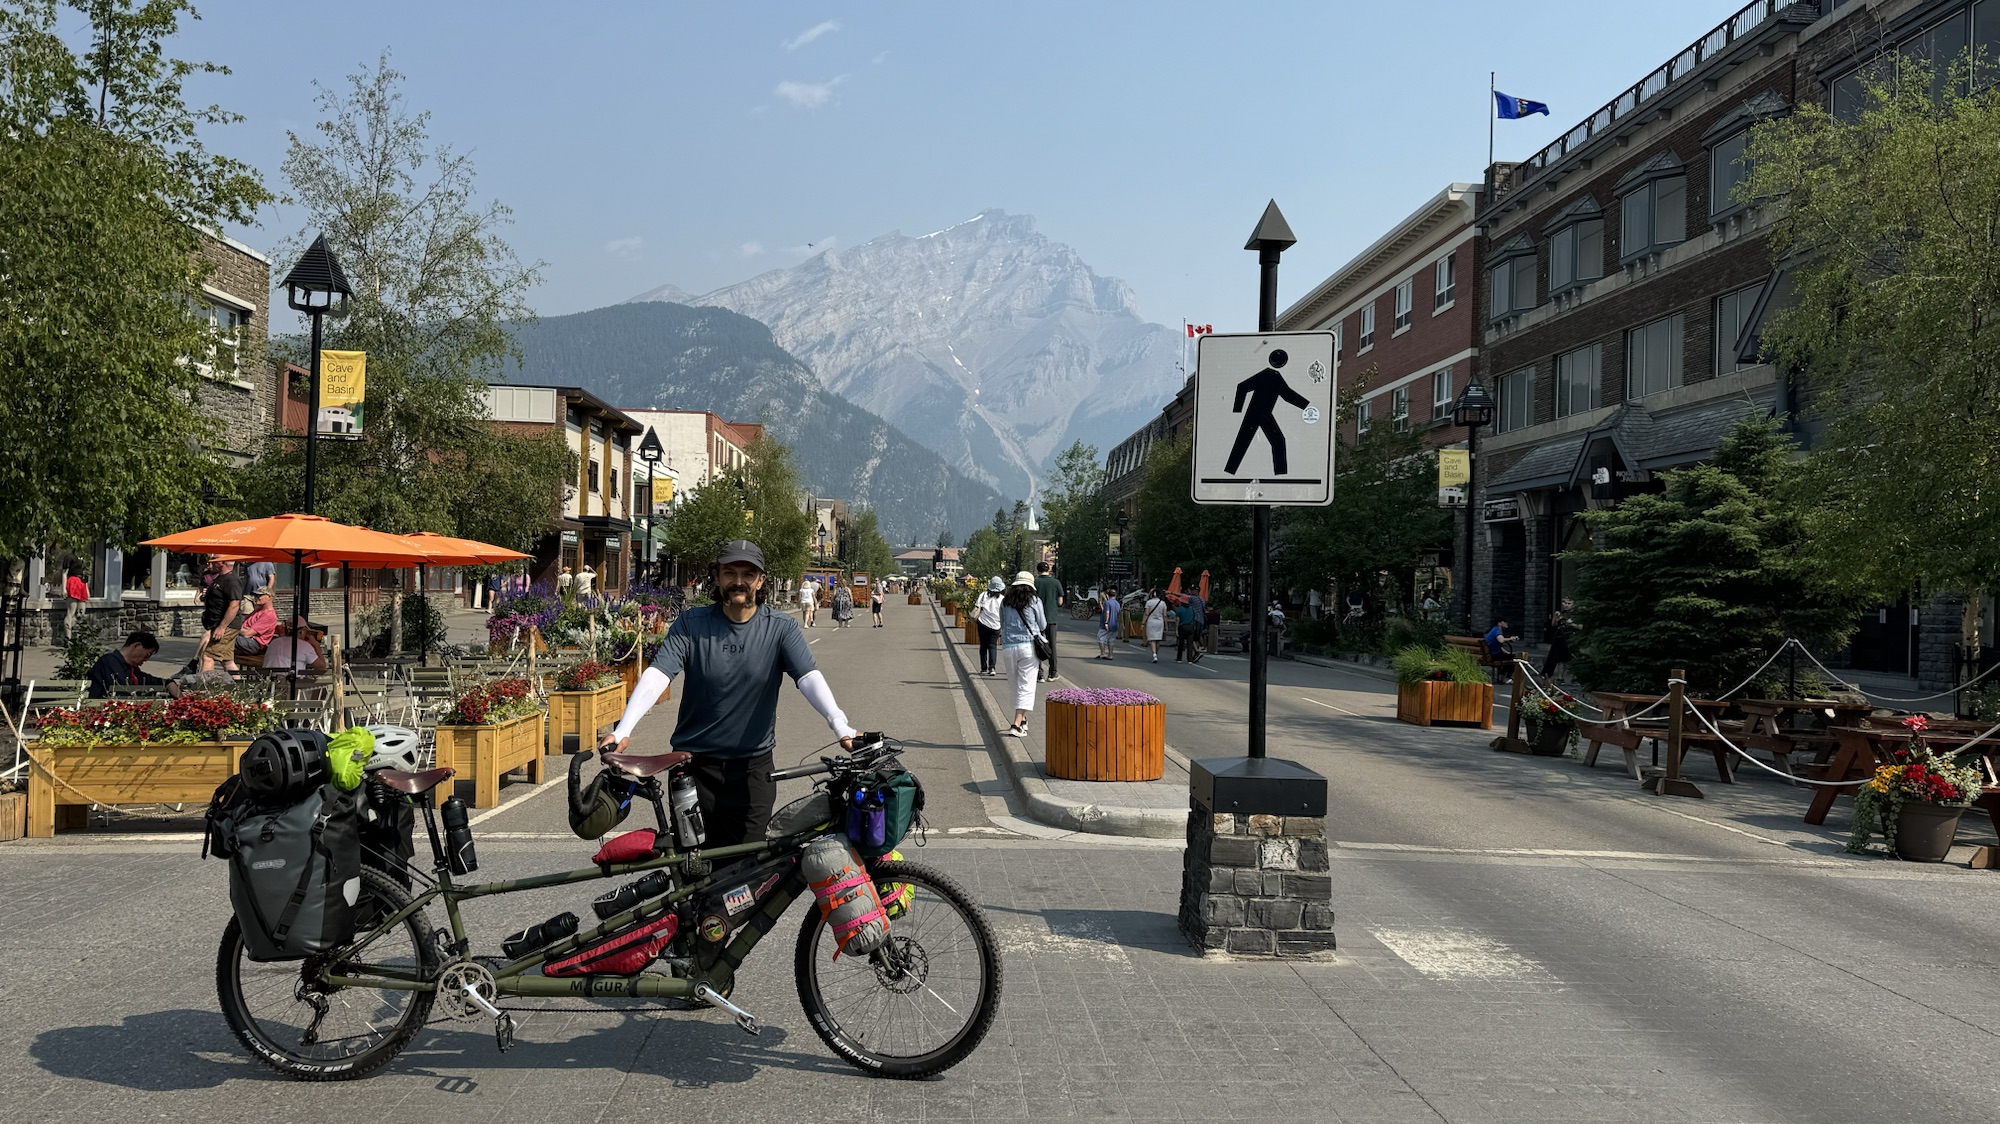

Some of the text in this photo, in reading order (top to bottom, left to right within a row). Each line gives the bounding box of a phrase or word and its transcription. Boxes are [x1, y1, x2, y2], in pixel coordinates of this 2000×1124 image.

[327, 362, 354, 373] Cave
[327, 374, 347, 383] and
[327, 384, 355, 394] Basin
[722, 644, 745, 653] FOX
[570, 980, 630, 993] MGUR
[814, 1012, 883, 1069] SCHWALBE
[242, 1029, 288, 1063] ROCKET
[290, 1062, 322, 1073] RON
